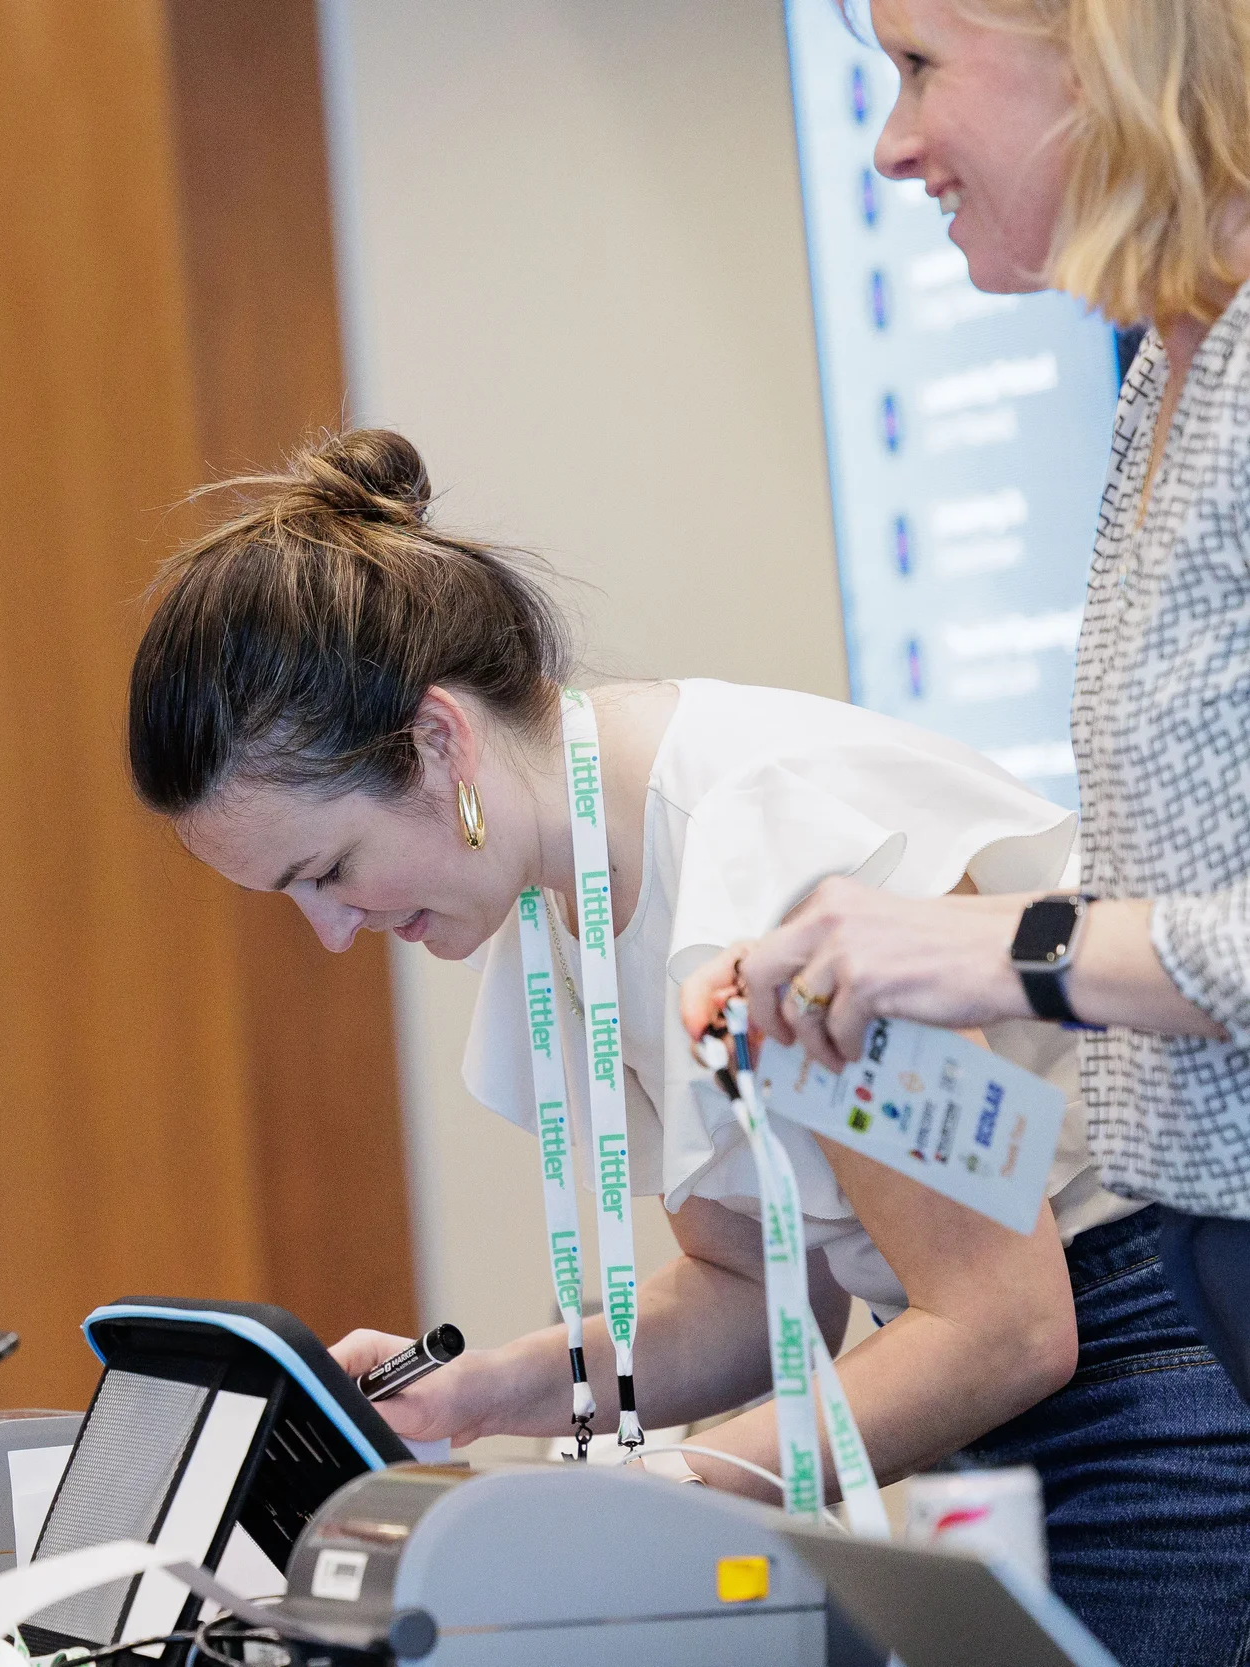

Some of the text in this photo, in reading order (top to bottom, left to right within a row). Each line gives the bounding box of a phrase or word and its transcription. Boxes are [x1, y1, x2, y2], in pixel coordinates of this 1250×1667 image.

[570, 742, 600, 827] Littler
[581, 870, 609, 959] Littler
[526, 972, 554, 1060] Littler
[590, 1002, 619, 1090] Littler
[539, 1101, 566, 1190] Littler
[599, 1133, 628, 1222] Littler
[551, 1230, 582, 1318] Littler
[606, 1265, 634, 1350] Littler
[391, 1347, 417, 1368] MARKER
[779, 1306, 808, 1396] Littler
[790, 1441, 821, 1519] ittler
